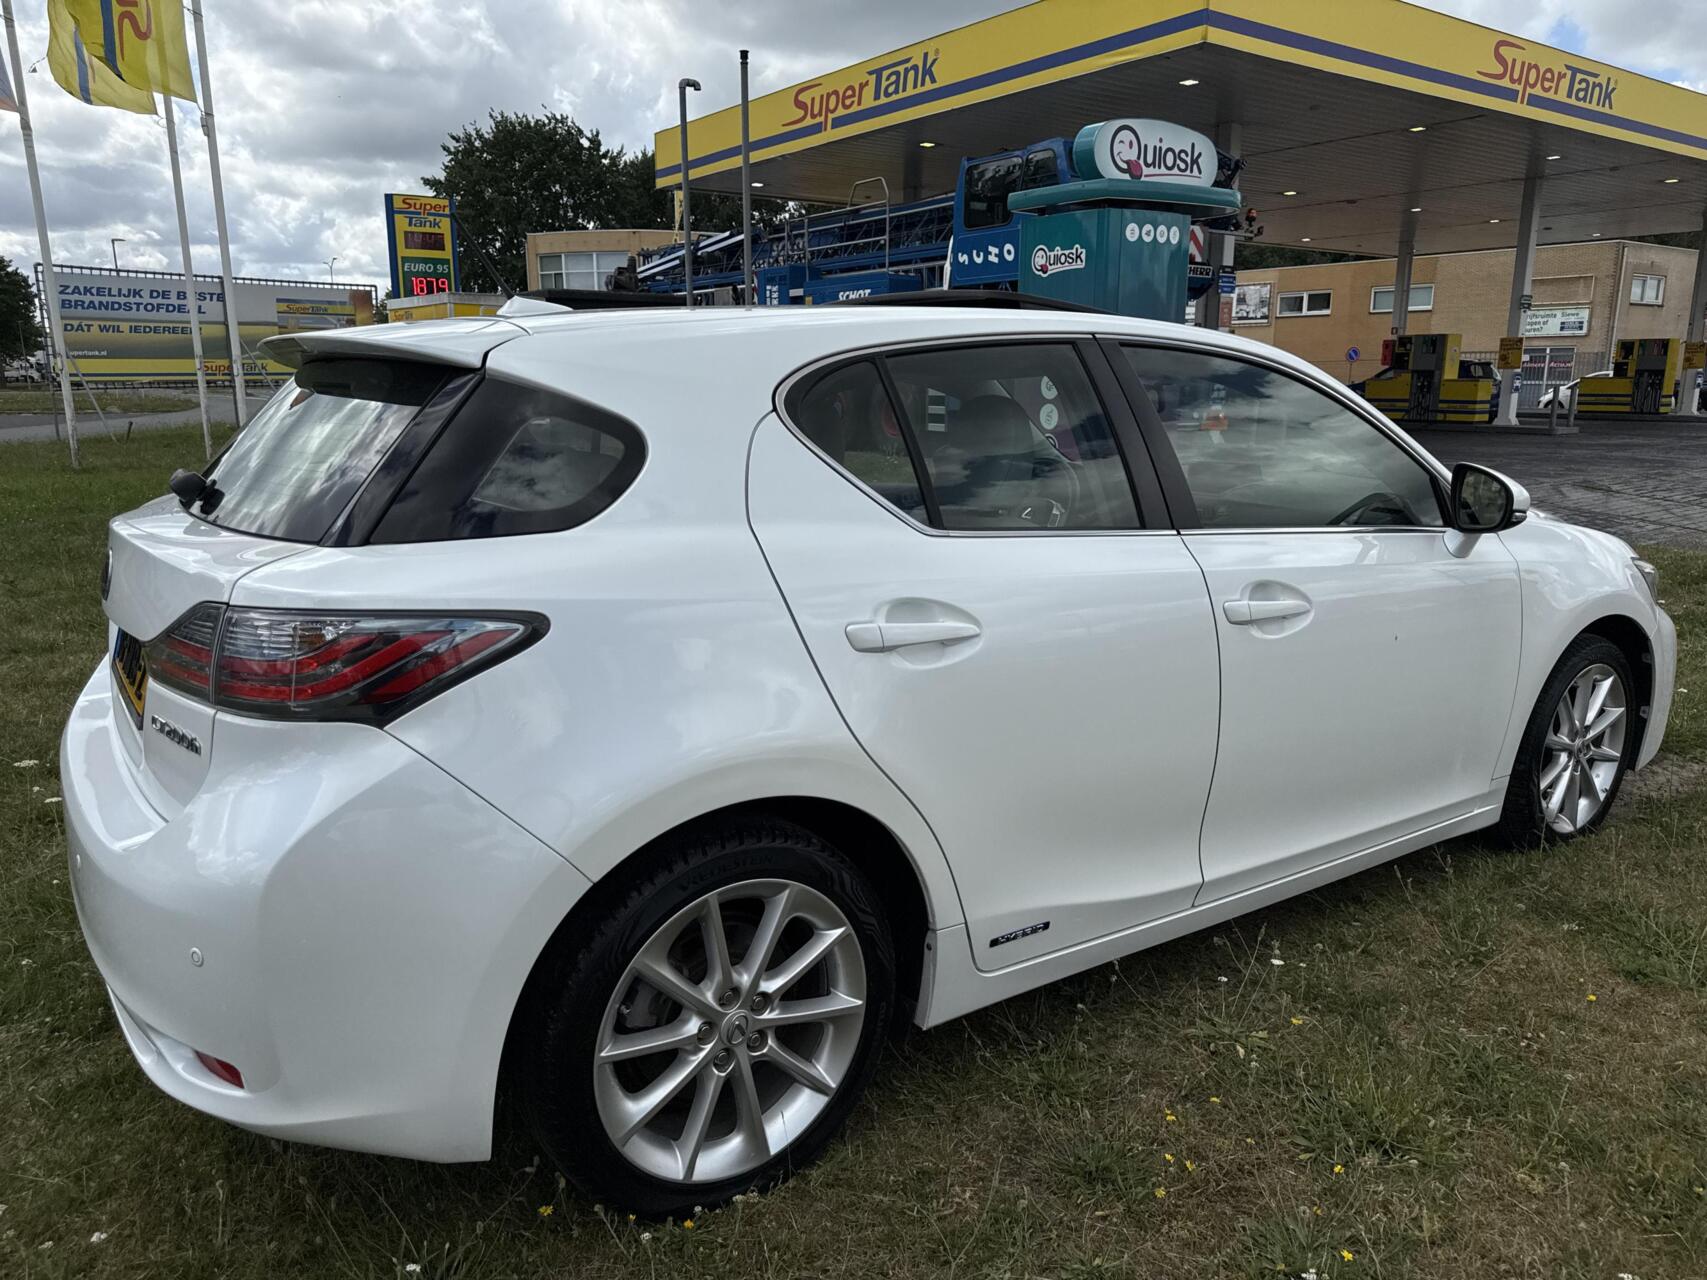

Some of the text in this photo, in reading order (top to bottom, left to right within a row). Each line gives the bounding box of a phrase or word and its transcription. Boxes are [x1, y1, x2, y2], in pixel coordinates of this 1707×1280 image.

[1110, 124, 1203, 180] Quiosk
[401, 197, 449, 216] Super
[404, 215, 442, 229] Tank
[404, 263, 449, 273] EURO 95
[1032, 246, 1085, 274] Quiosk
[58, 284, 225, 303] ZAKELIJK DE BSTE
[411, 277, 450, 296] 1879
[60, 299, 207, 314] BRANDSTOFDEL
[63, 322, 94, 333] DÁT
[98, 323, 124, 334] WIL
